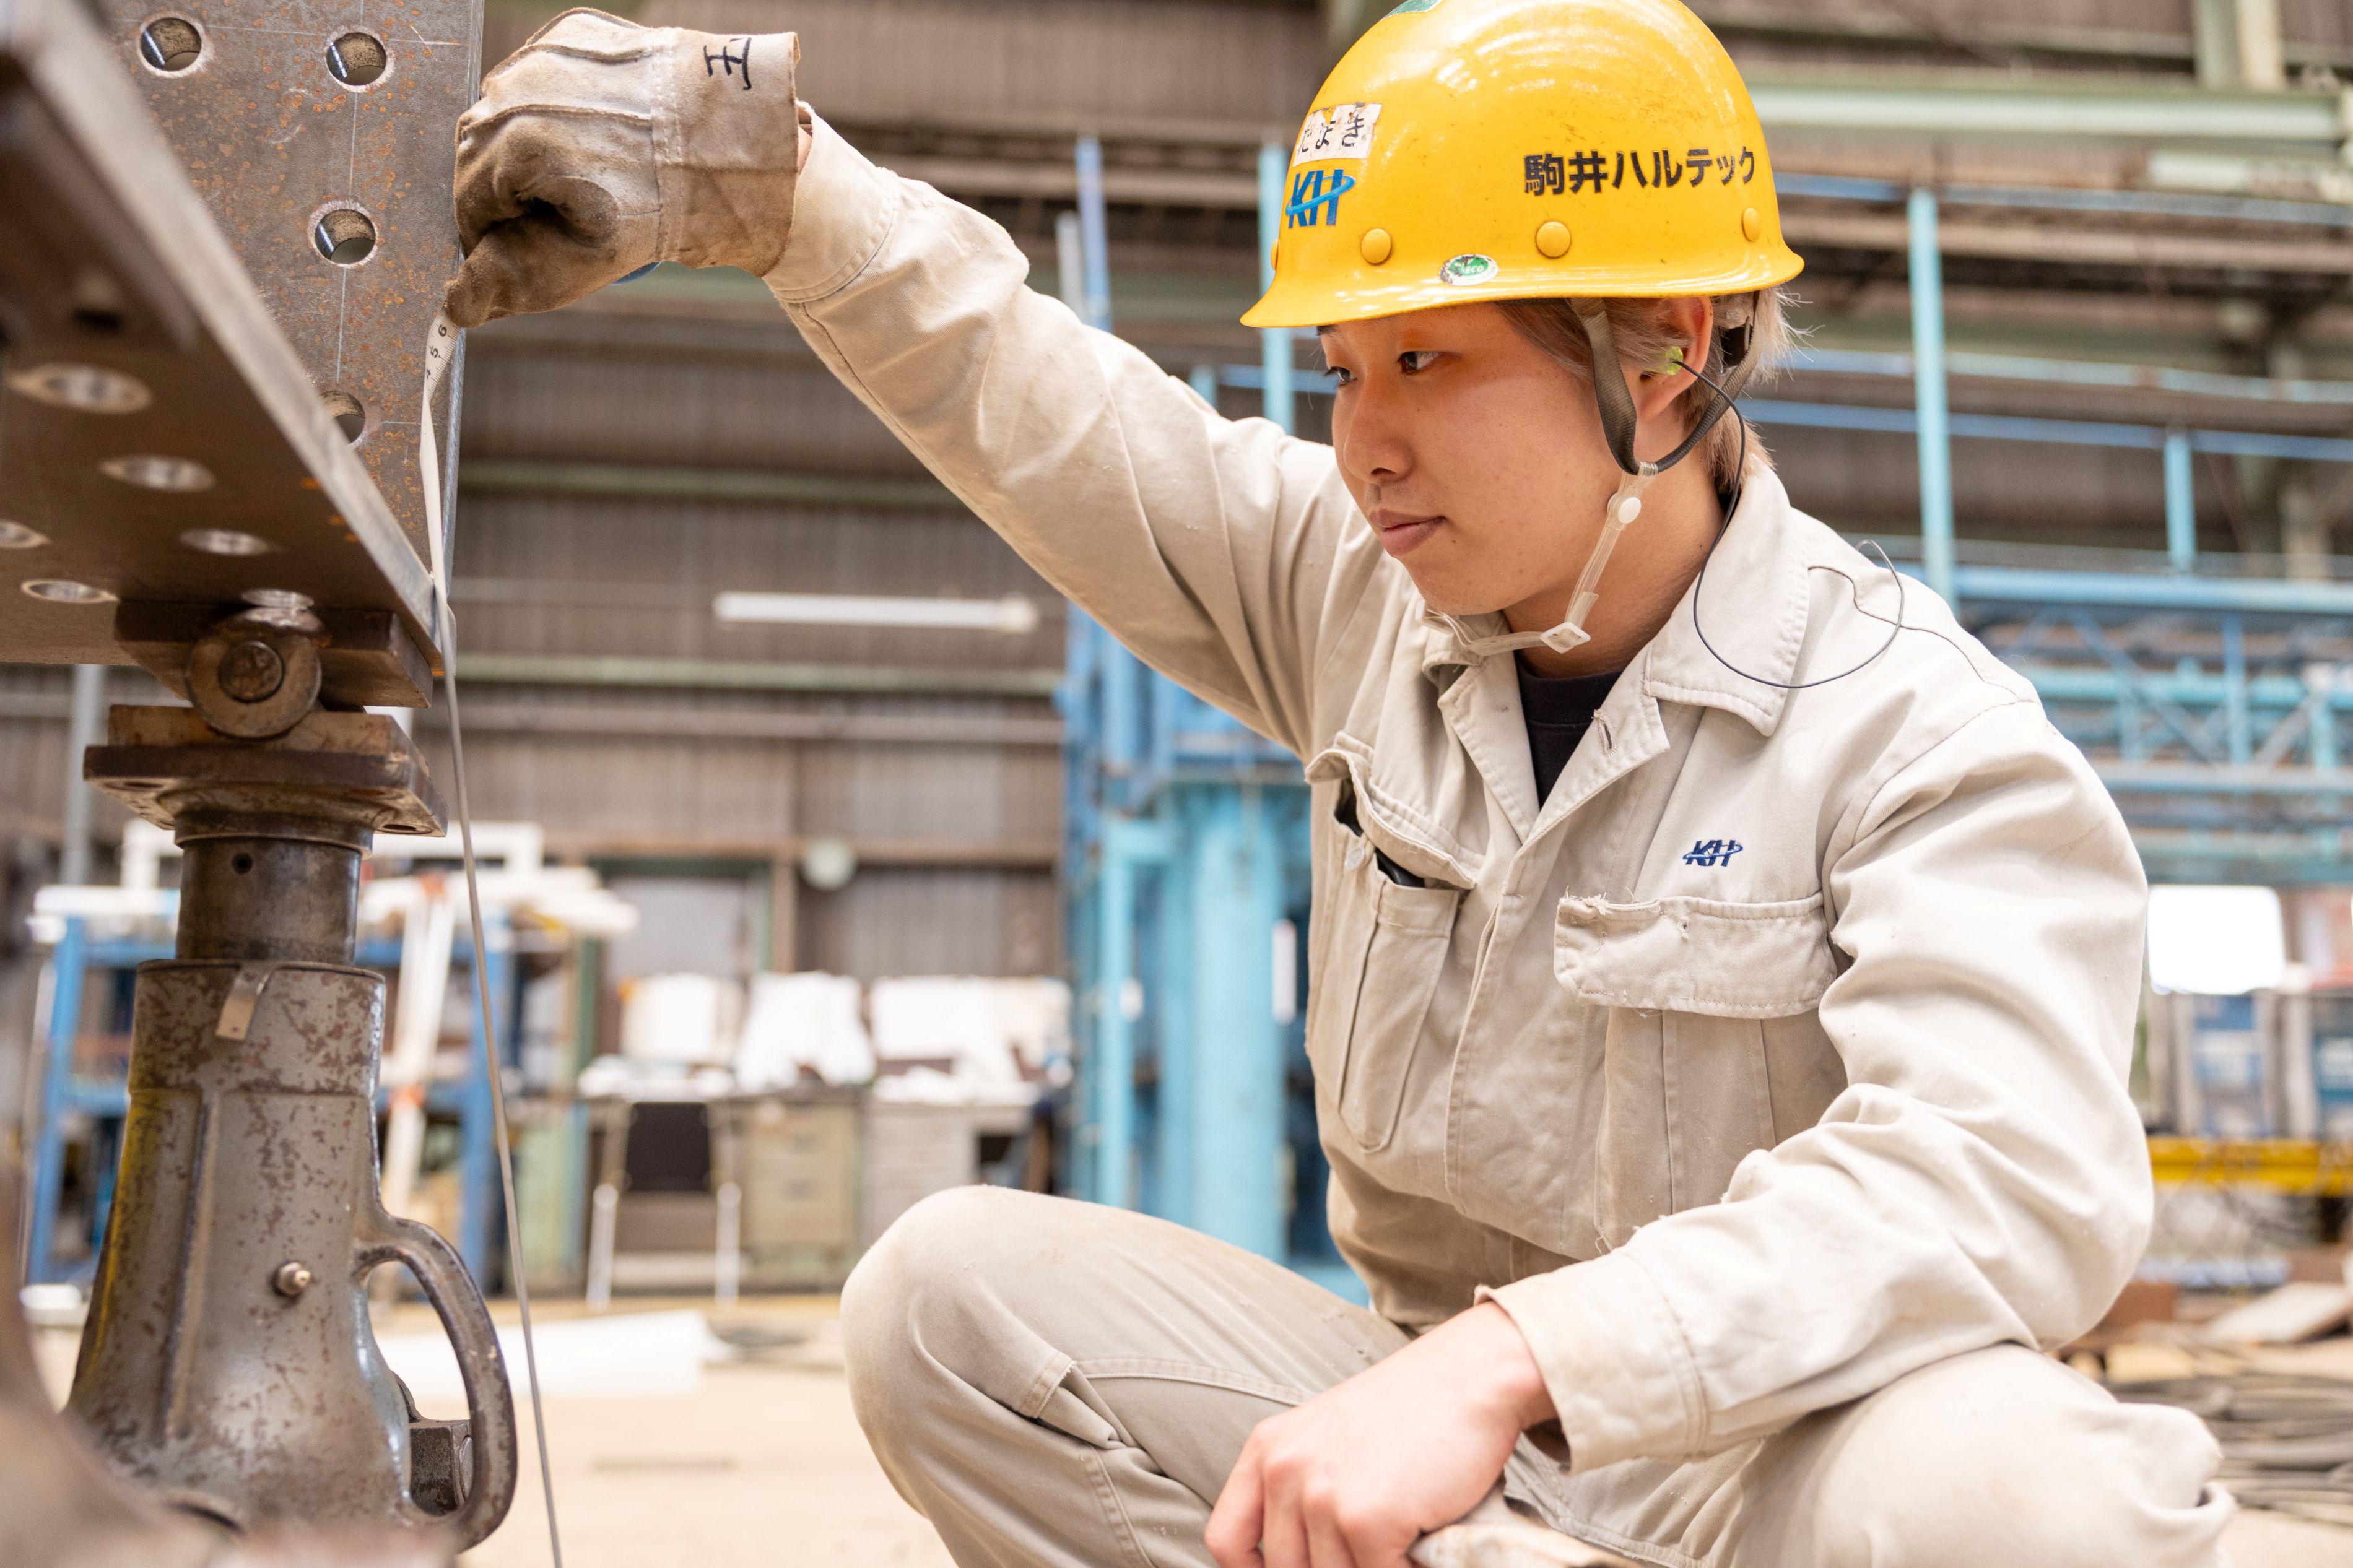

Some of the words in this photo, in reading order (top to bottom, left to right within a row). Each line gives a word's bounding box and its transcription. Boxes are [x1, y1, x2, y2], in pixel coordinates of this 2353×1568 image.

[1523, 145, 1754, 196] 駒井ハルテック
[1285, 168, 1356, 228] KH
[429, 345, 439, 359] 5
[438, 324, 447, 337] 6
[1682, 839, 1744, 867] KH
